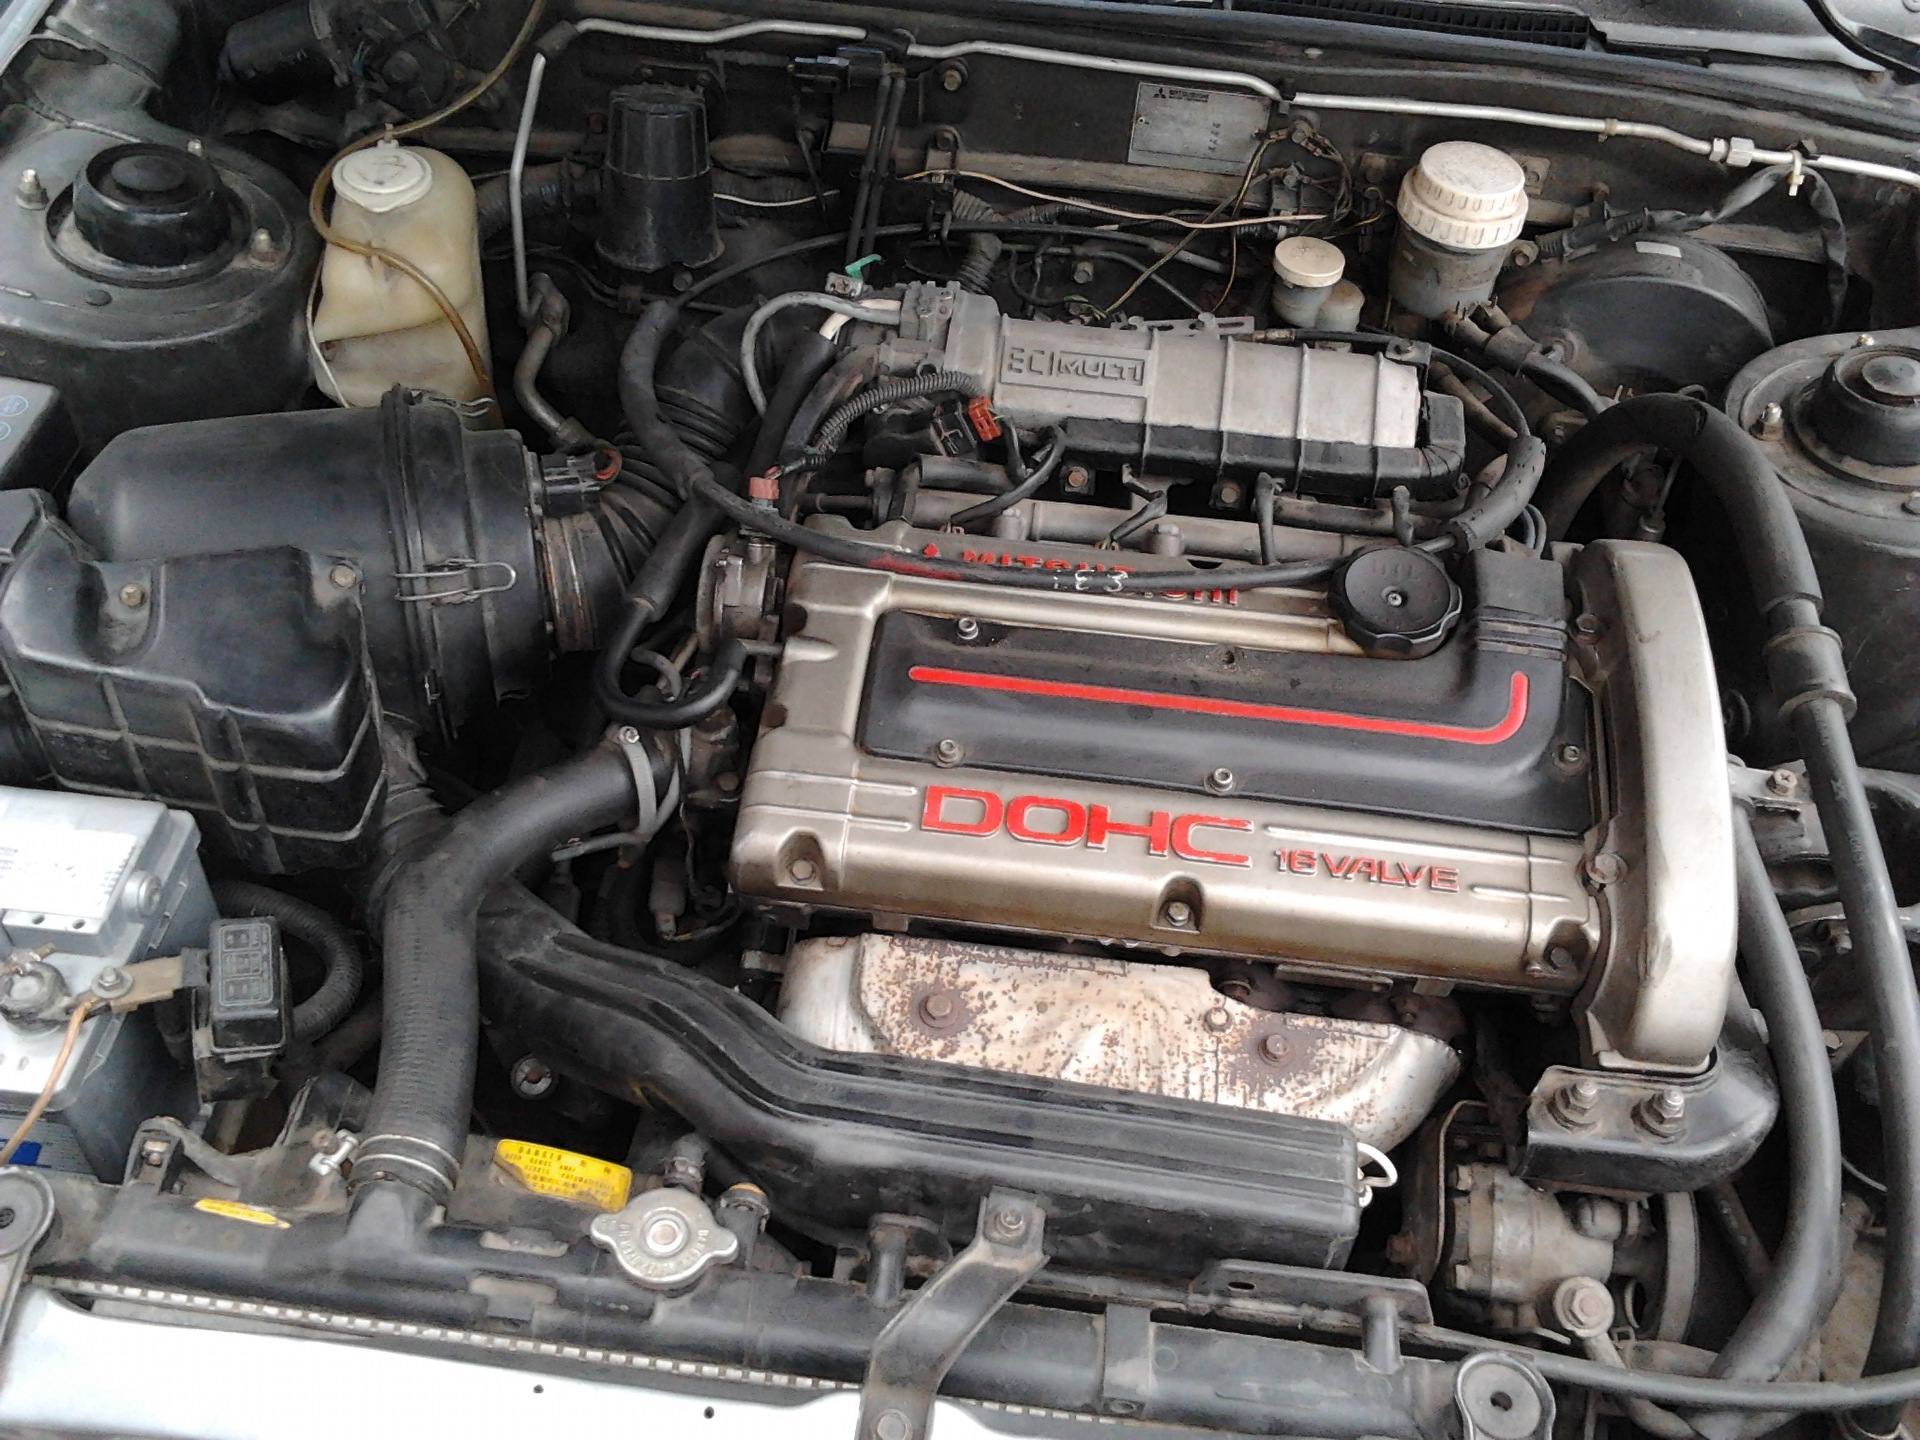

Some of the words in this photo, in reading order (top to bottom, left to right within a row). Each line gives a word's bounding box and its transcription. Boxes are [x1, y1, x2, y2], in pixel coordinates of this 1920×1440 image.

[1057, 357, 1141, 383] MULTI
[920, 784, 1254, 869] DOHC
[1320, 852, 1460, 893] VALVE
